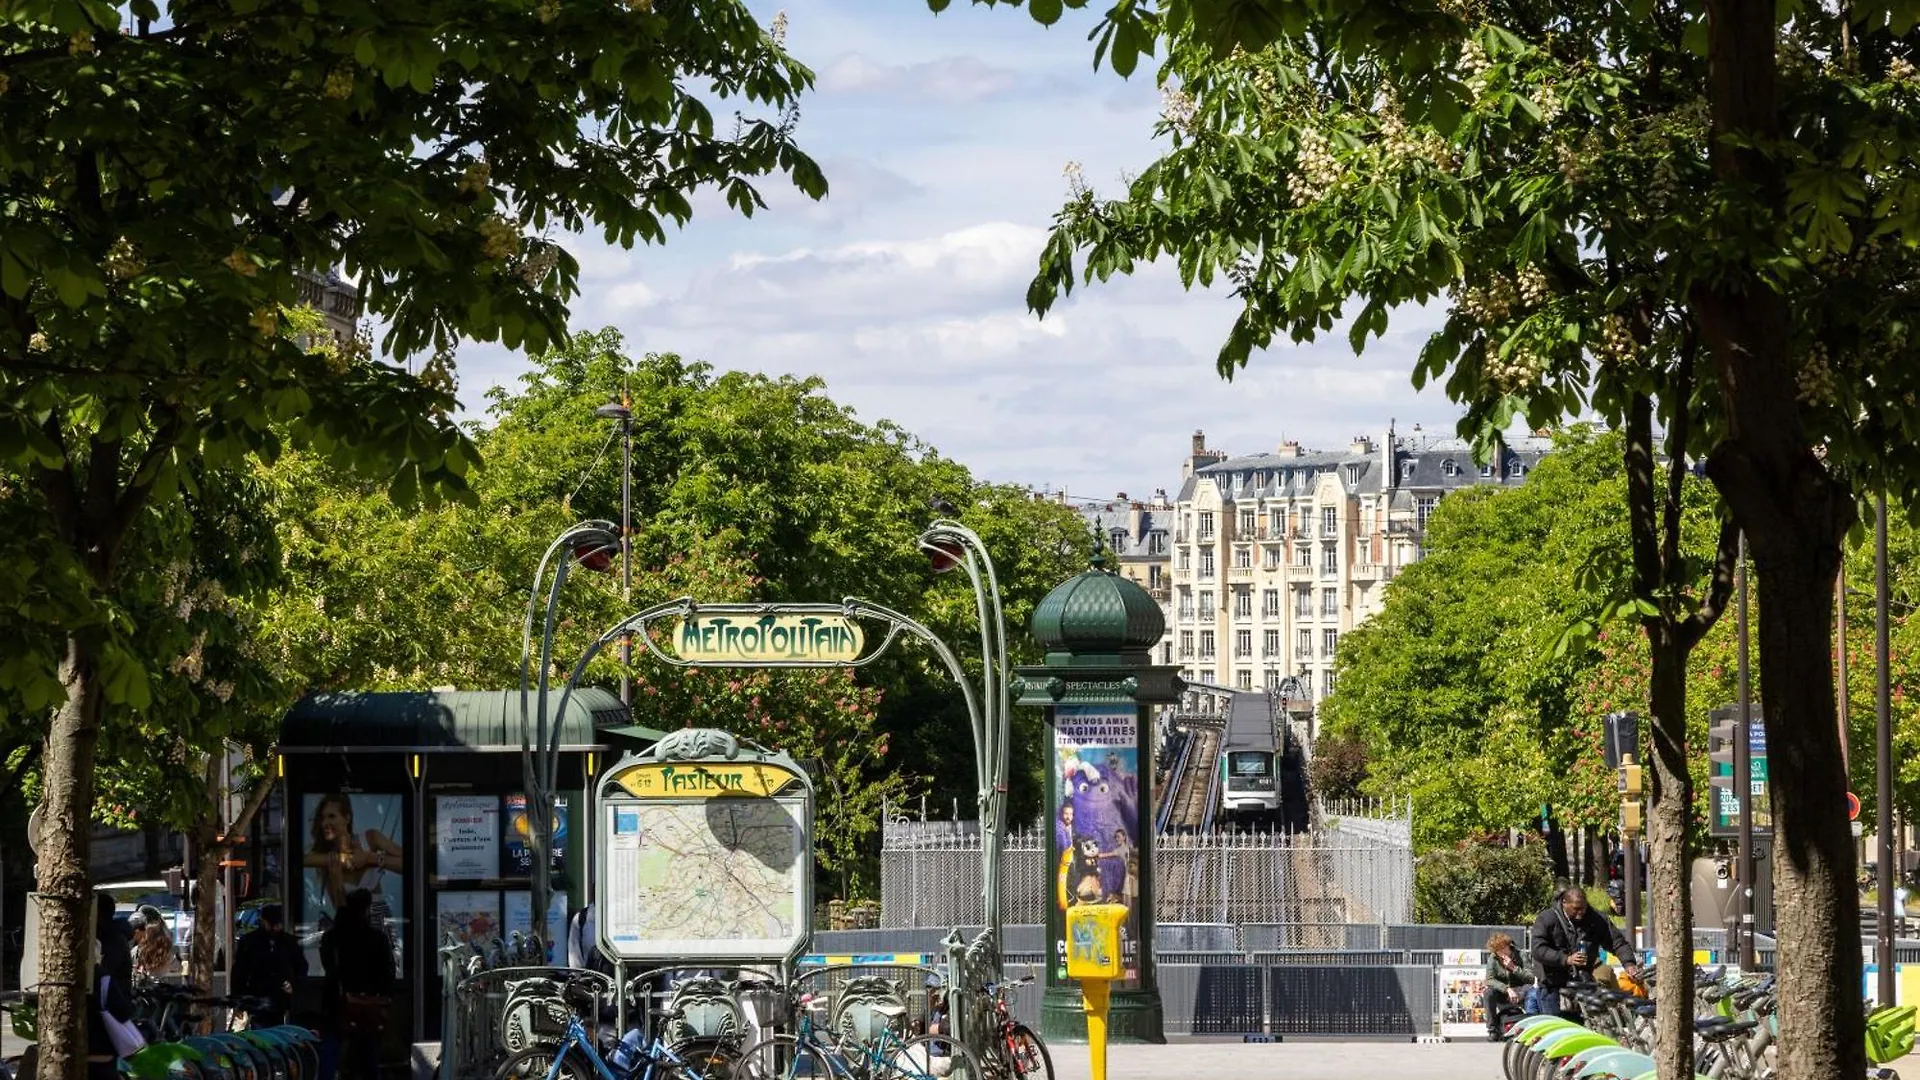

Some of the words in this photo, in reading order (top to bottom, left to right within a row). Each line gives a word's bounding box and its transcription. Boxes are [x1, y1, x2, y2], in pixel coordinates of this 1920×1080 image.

[682, 614, 856, 659] METROPOLITAIN
[1065, 681, 1121, 691] SPECTACLES
[1083, 717, 1103, 725] VOS
[1105, 717, 1129, 725] AMIS
[1056, 726, 1136, 736] IMAGINAIRES
[661, 766, 748, 793] PASTEUR
[512, 848, 522, 858] LA
